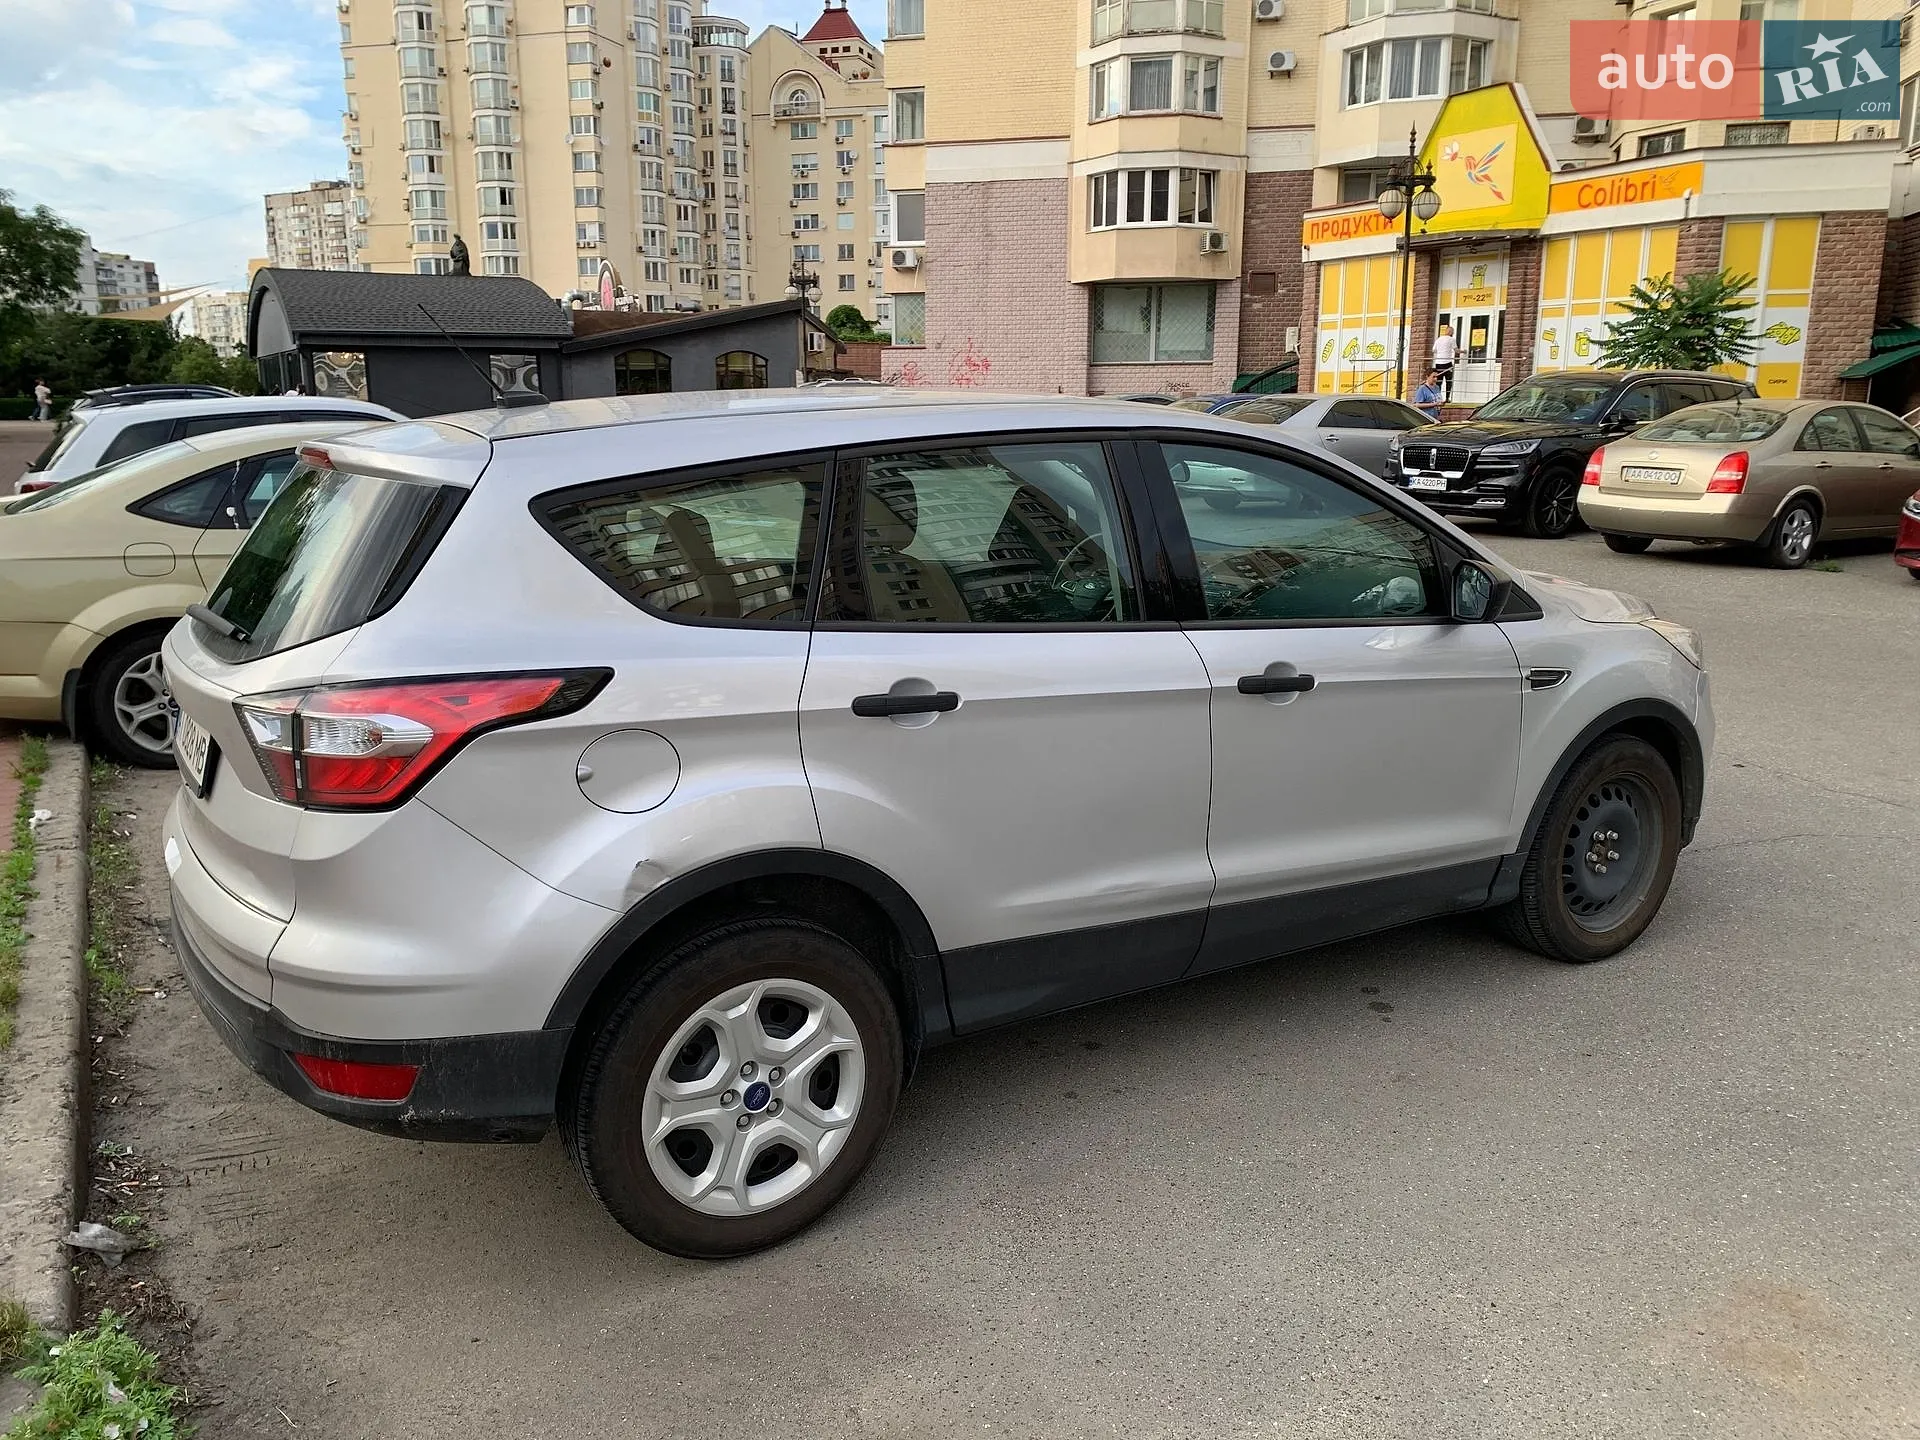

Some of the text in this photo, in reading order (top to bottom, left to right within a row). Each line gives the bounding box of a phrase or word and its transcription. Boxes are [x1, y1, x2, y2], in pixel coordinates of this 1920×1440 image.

[1577, 174, 1657, 209] Colibri
[1310, 213, 1394, 240] ПРОДУКТИ
[1412, 478, 1446, 487] KA 4220 PH
[1631, 469, 1642, 479] AA
[1643, 470, 1663, 480] 0412
